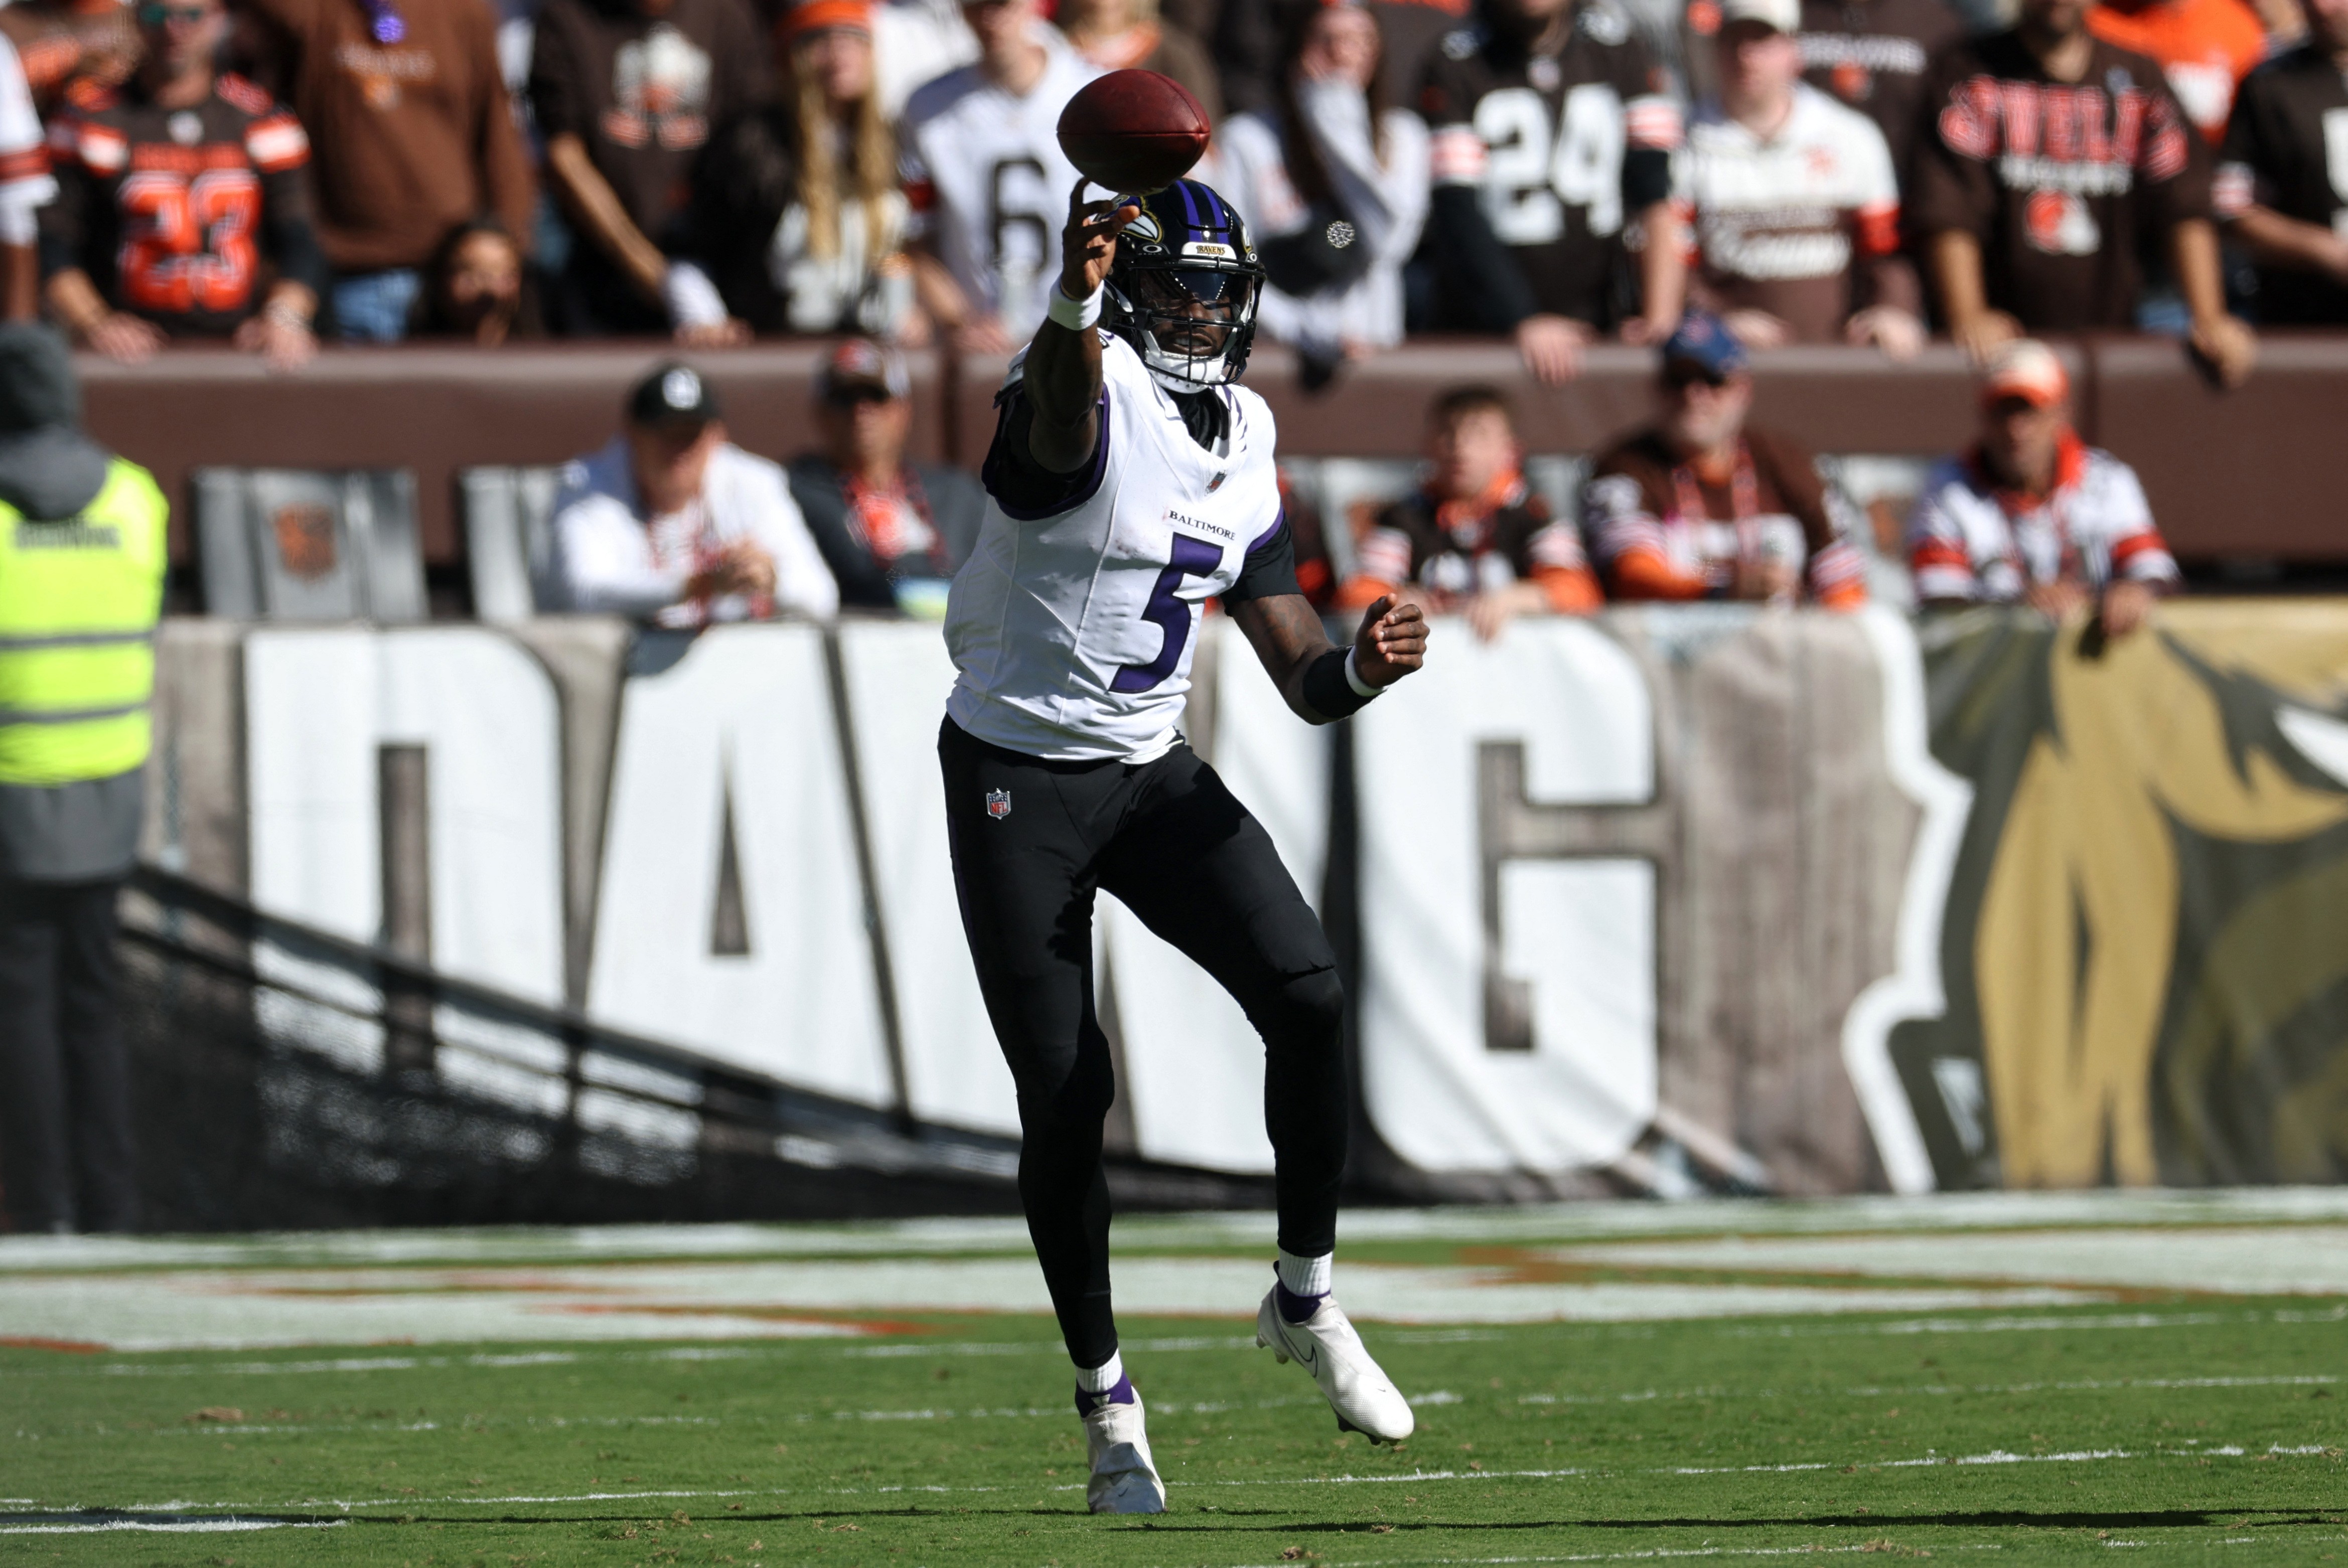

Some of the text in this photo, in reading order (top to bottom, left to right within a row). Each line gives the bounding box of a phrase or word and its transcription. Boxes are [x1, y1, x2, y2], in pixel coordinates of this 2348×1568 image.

[1471, 83, 1625, 245] 24
[990, 156, 1049, 277] 6
[1196, 245, 1225, 255] RAVENS
[1168, 510, 1236, 541] BALTIMORE
[1108, 532, 1225, 694] 5
[991, 802, 1008, 814] NFL
